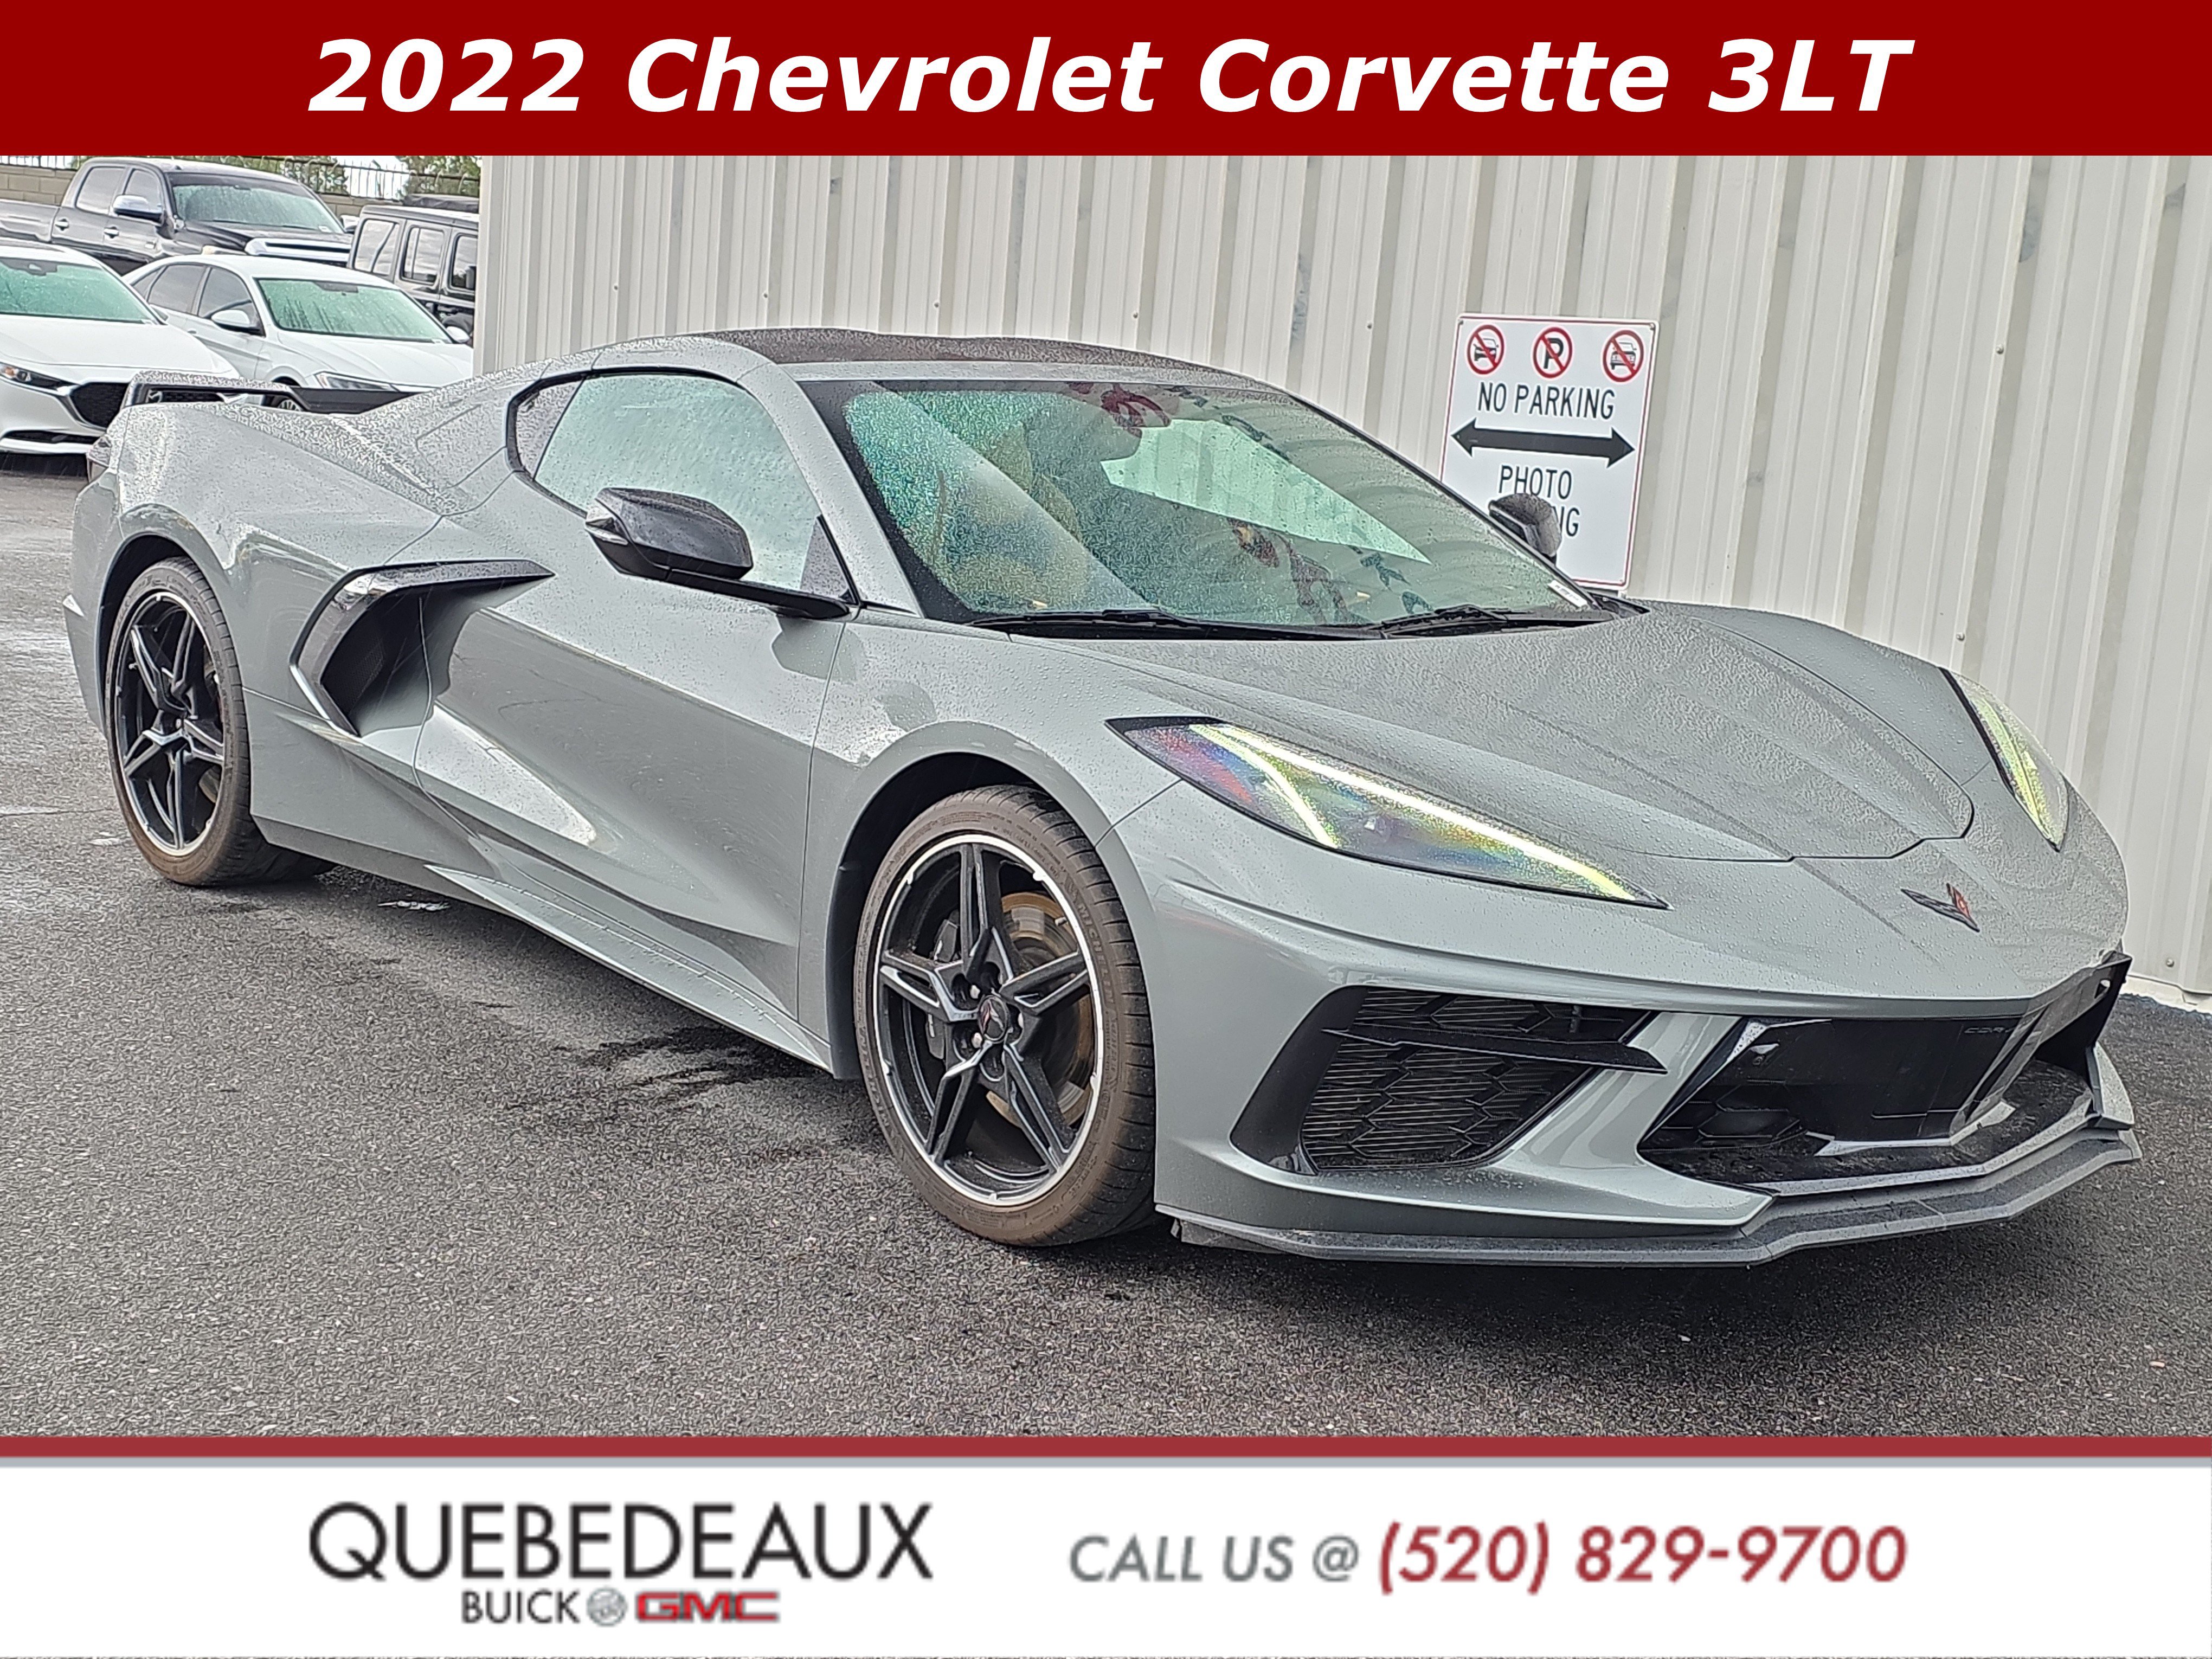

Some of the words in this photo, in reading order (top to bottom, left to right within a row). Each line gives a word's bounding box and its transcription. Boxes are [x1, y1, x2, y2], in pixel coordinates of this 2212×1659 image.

[1478, 382, 1507, 413] NO
[1514, 384, 1615, 420] PARKING
[1499, 464, 1572, 500] PHOTO
